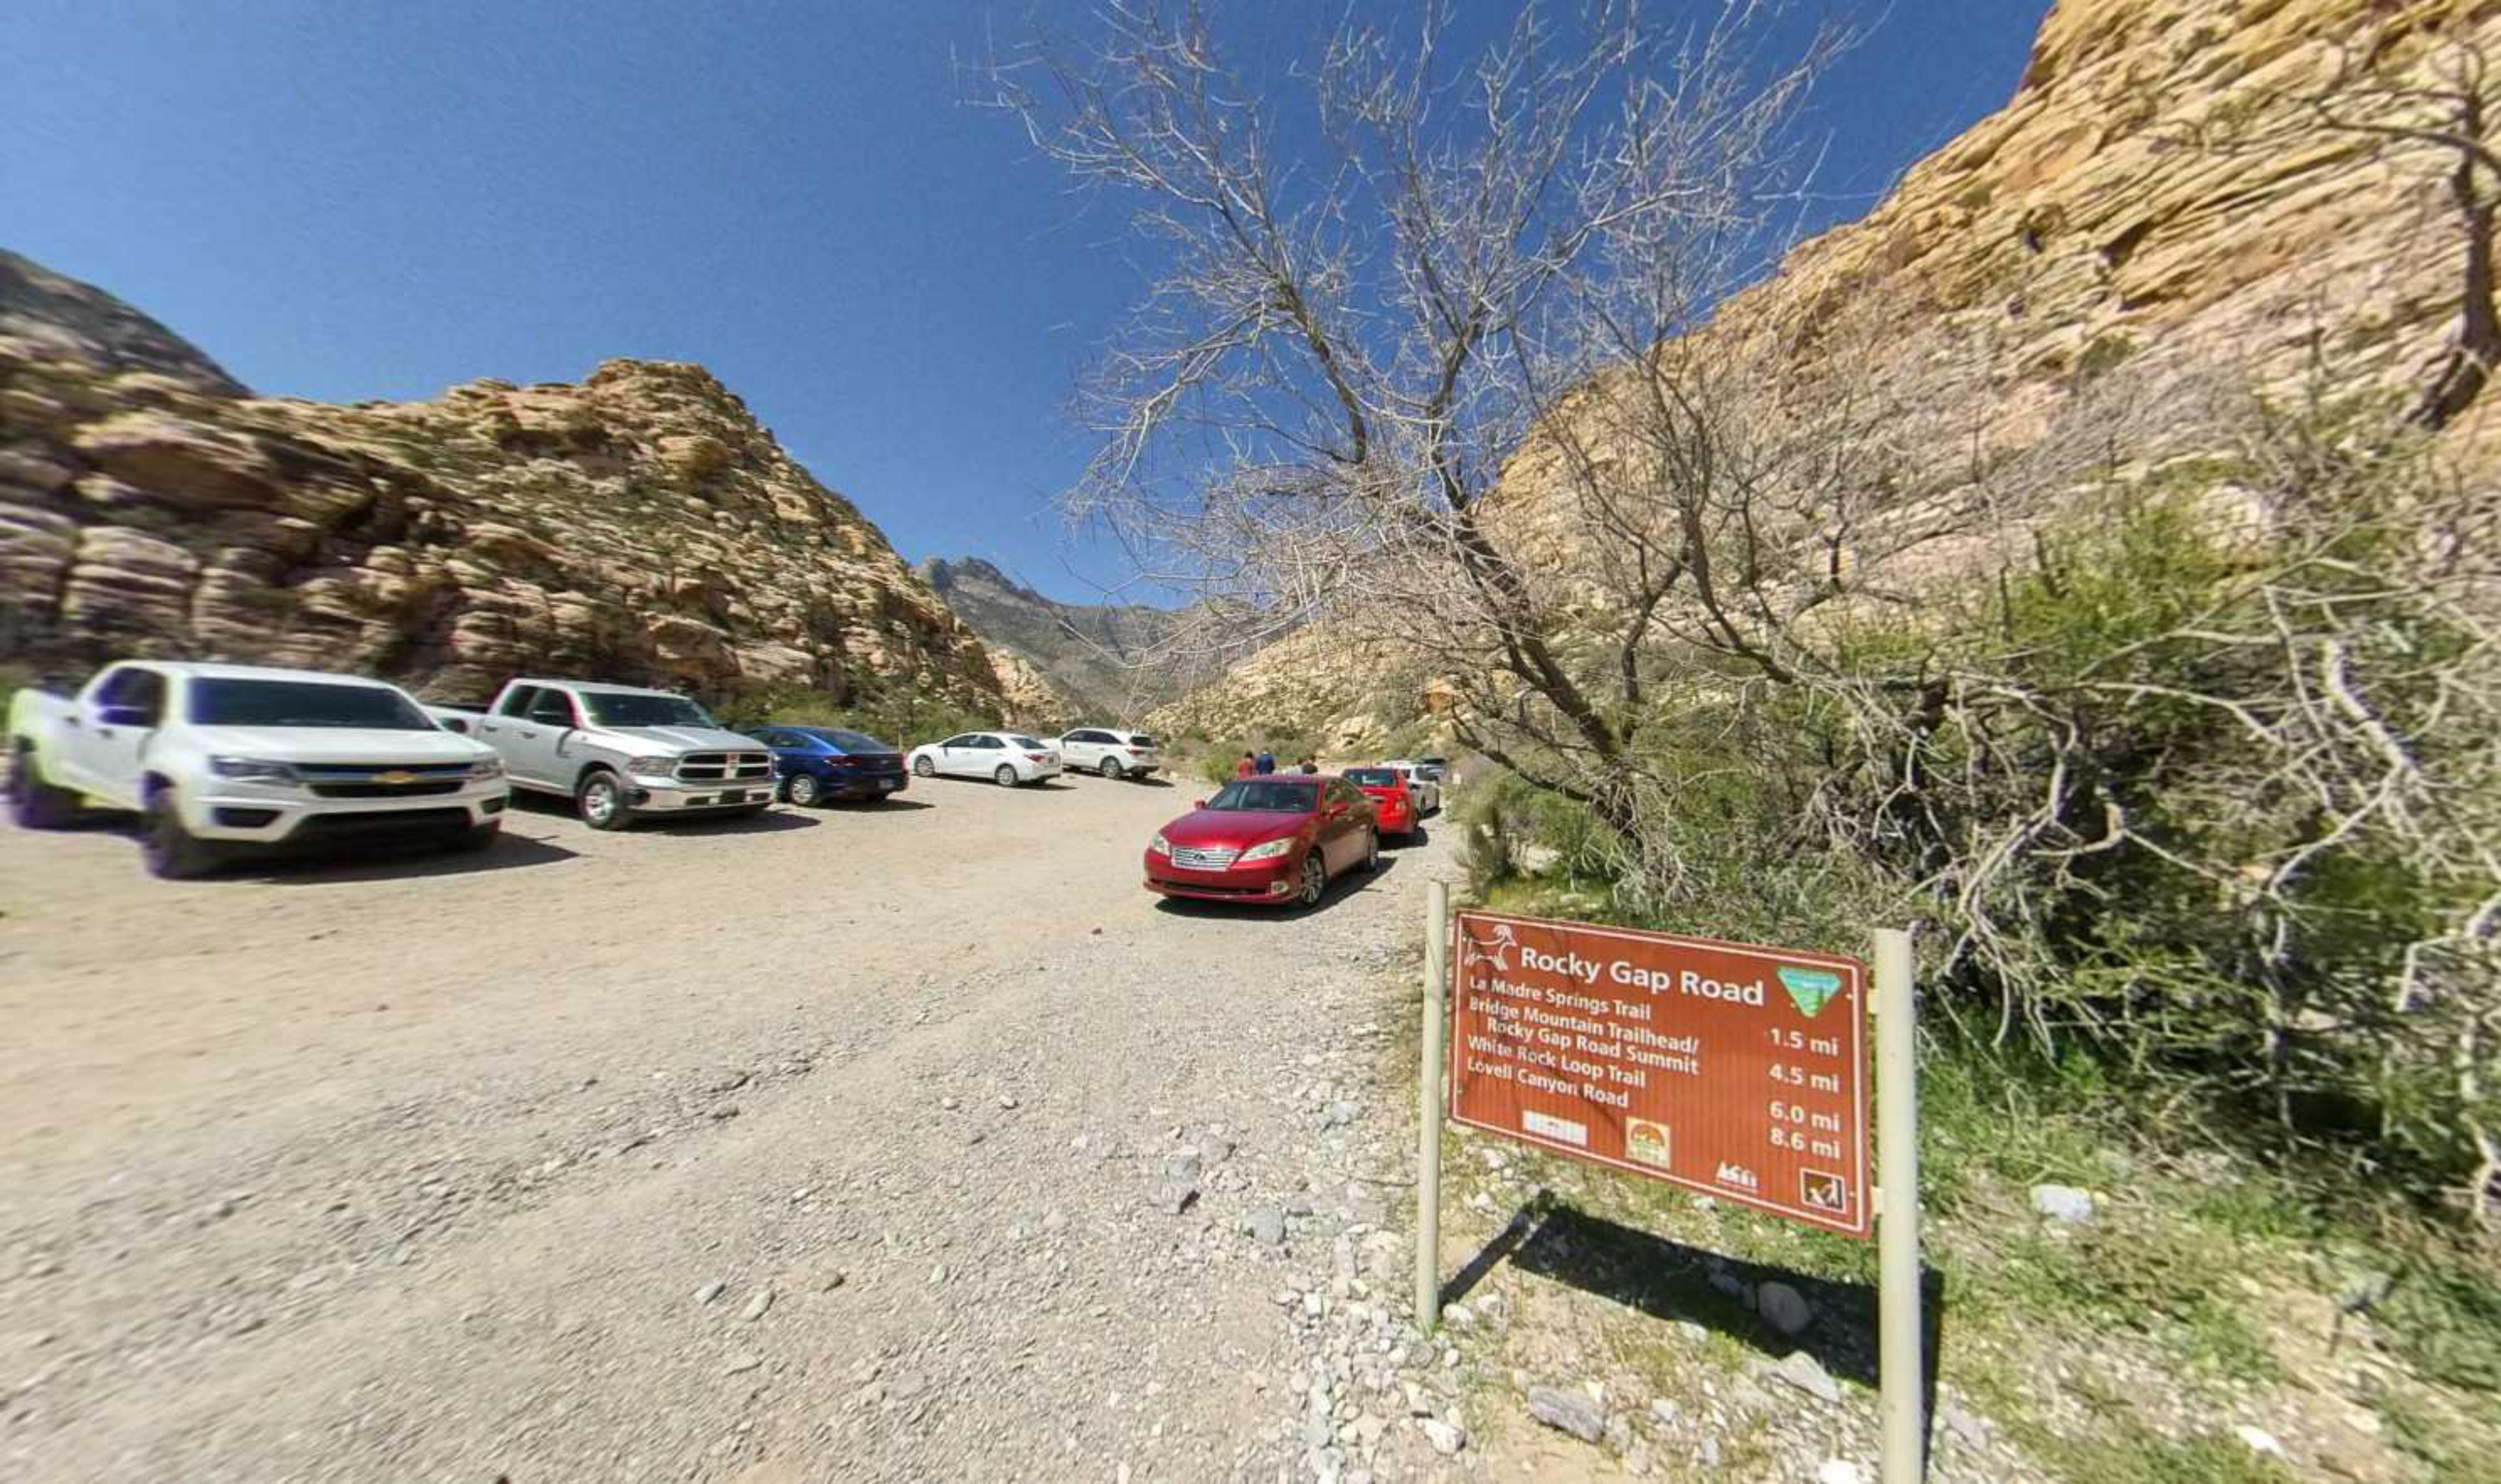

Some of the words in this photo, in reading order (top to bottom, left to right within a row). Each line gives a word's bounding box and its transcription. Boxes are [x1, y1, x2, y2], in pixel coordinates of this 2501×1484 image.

[1469, 975, 1487, 990] La
[1491, 979, 1542, 1001] Madre
[1546, 988, 1609, 1015] Springs
[1613, 999, 1651, 1020] Trail
[1521, 947, 1602, 983] Rocky
[1609, 960, 1670, 995] Gap
[1680, 970, 1764, 1006] Road
[1469, 996, 1519, 1020] Bridge
[1523, 1007, 1604, 1034] Mountain
[1608, 1022, 1699, 1054] Trailhead/
[1488, 1017, 1534, 1043] Rocky
[1538, 1028, 1572, 1050] Gap
[1576, 1035, 1621, 1058] Road
[1626, 1044, 1699, 1075] Summit
[1770, 1028, 1804, 1050] 1.5
[1809, 1037, 1839, 1057] mi
[1467, 1034, 1512, 1056] White
[1518, 1046, 1557, 1067] Rock
[1561, 1054, 1604, 1081] Loop
[1607, 1065, 1645, 1087] Trail
[1467, 1056, 1512, 1079] Lovell
[1518, 1069, 1578, 1096] Canyon
[1583, 1082, 1629, 1108] Road
[1768, 1063, 1804, 1085] 4.5
[1810, 1074, 1839, 1093] mi
[1770, 1101, 1805, 1124] 6.0
[1811, 1112, 1840, 1132] mi
[1770, 1127, 1805, 1151] 8.6
[1811, 1140, 1840, 1160] mi
